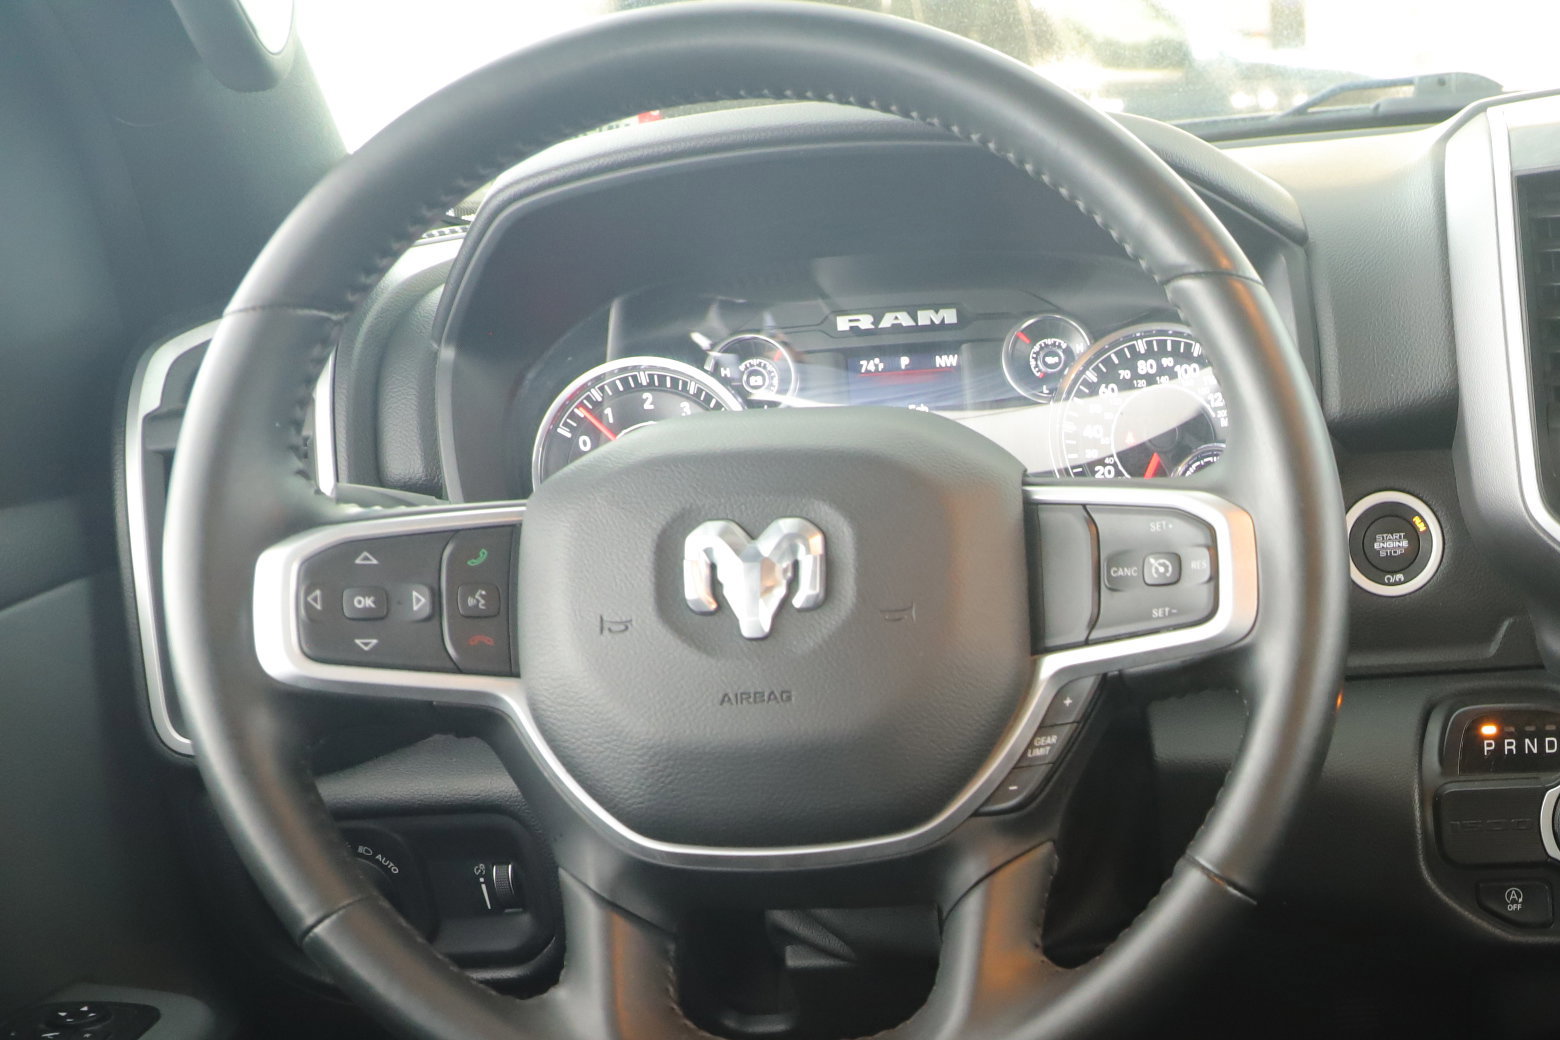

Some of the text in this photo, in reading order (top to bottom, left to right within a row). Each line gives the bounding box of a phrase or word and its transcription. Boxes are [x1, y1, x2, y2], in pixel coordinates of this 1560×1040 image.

[836, 308, 958, 331] RAM
[900, 356, 910, 370] P
[935, 354, 958, 368] NW
[1137, 360, 1157, 374] 80
[1161, 358, 1174, 367] 90
[720, 367, 731, 378] H
[1118, 370, 1131, 380] 70
[1174, 363, 1200, 379] 100
[1042, 385, 1049, 393] L
[1099, 384, 1119, 398] 60
[1133, 380, 1146, 388] 120
[642, 393, 654, 409] 2
[1207, 393, 1225, 408] 12
[604, 407, 614, 423] 1
[680, 402, 691, 416] 3
[578, 436, 592, 451] 0
[1094, 466, 1115, 479] 20
[1375, 533, 1405, 541] START
[1374, 540, 1409, 549] ENGINE
[1379, 548, 1405, 557] STOP
[1191, 560, 1207, 569] RES
[1110, 567, 1138, 577] CANC
[354, 595, 376, 609] OK
[719, 690, 793, 706] AIRBAG
[1034, 735, 1058, 747] GEAR
[1484, 737, 1558, 756] P R N D
[1027, 746, 1051, 757] LIMIT
[375, 854, 399, 874] AUTO
